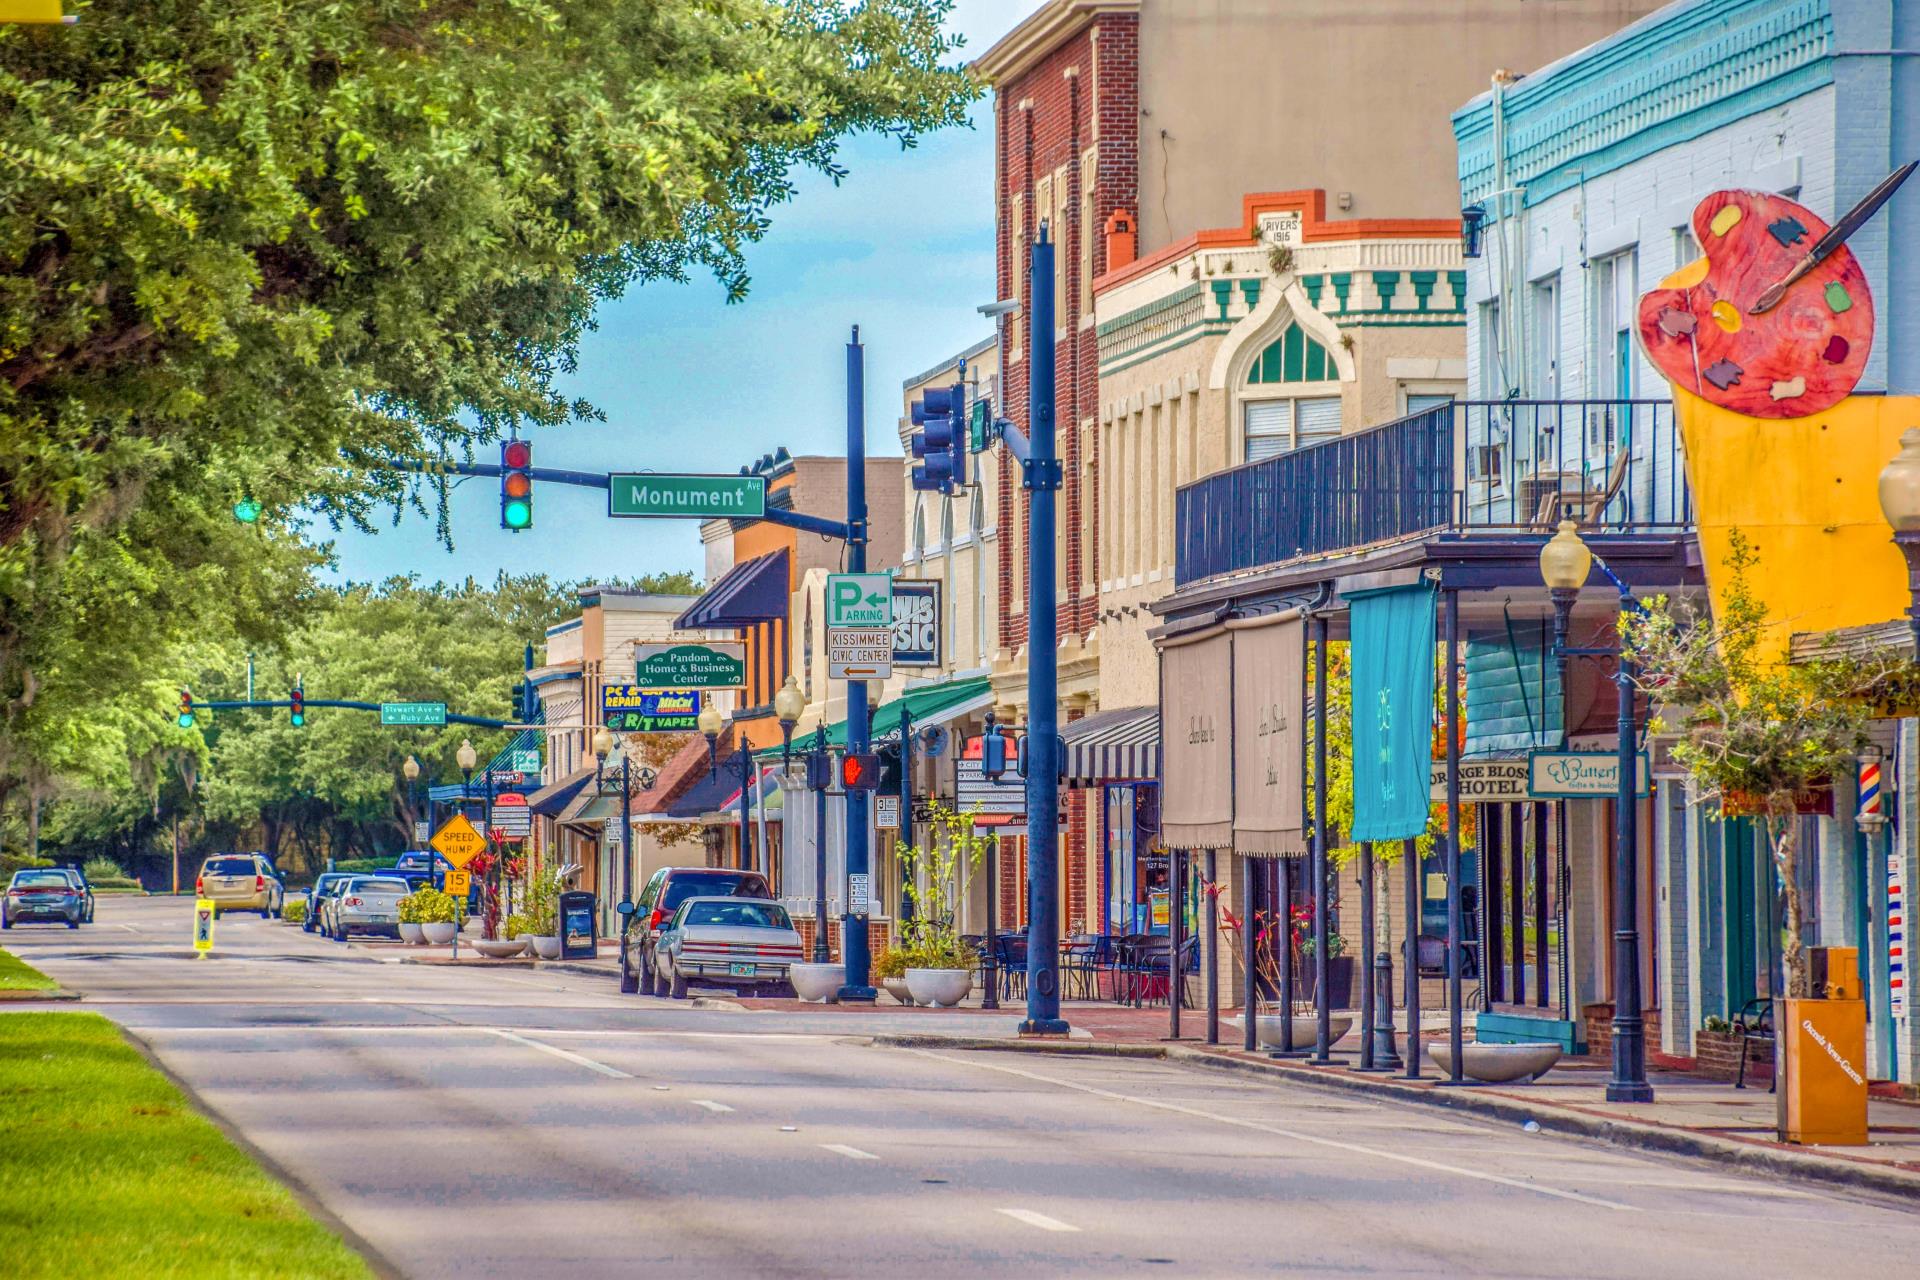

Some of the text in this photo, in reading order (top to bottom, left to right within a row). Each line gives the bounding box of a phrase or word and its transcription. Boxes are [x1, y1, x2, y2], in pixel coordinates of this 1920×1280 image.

[1266, 220, 1298, 231] RIVERS
[631, 480, 761, 507] Monument Ave
[893, 595, 934, 624] WIS
[832, 633, 889, 646] KISSIMMEE
[893, 623, 934, 651] SIC
[670, 653, 710, 663] Pandom
[832, 650, 888, 662] CIVIC CENTER
[645, 663, 735, 674] Home & Business
[672, 674, 709, 684] Center
[605, 686, 624, 697] PC
[605, 696, 642, 707] REPAIR
[656, 716, 696, 728] VAPEZ
[1430, 766, 1484, 785] ORNGE
[1547, 758, 1618, 784] Butterf
[1460, 780, 1523, 795] HOTEL
[443, 832, 475, 842] SPEED
[446, 845, 473, 854] HUMP
[449, 873, 465, 886] 15
